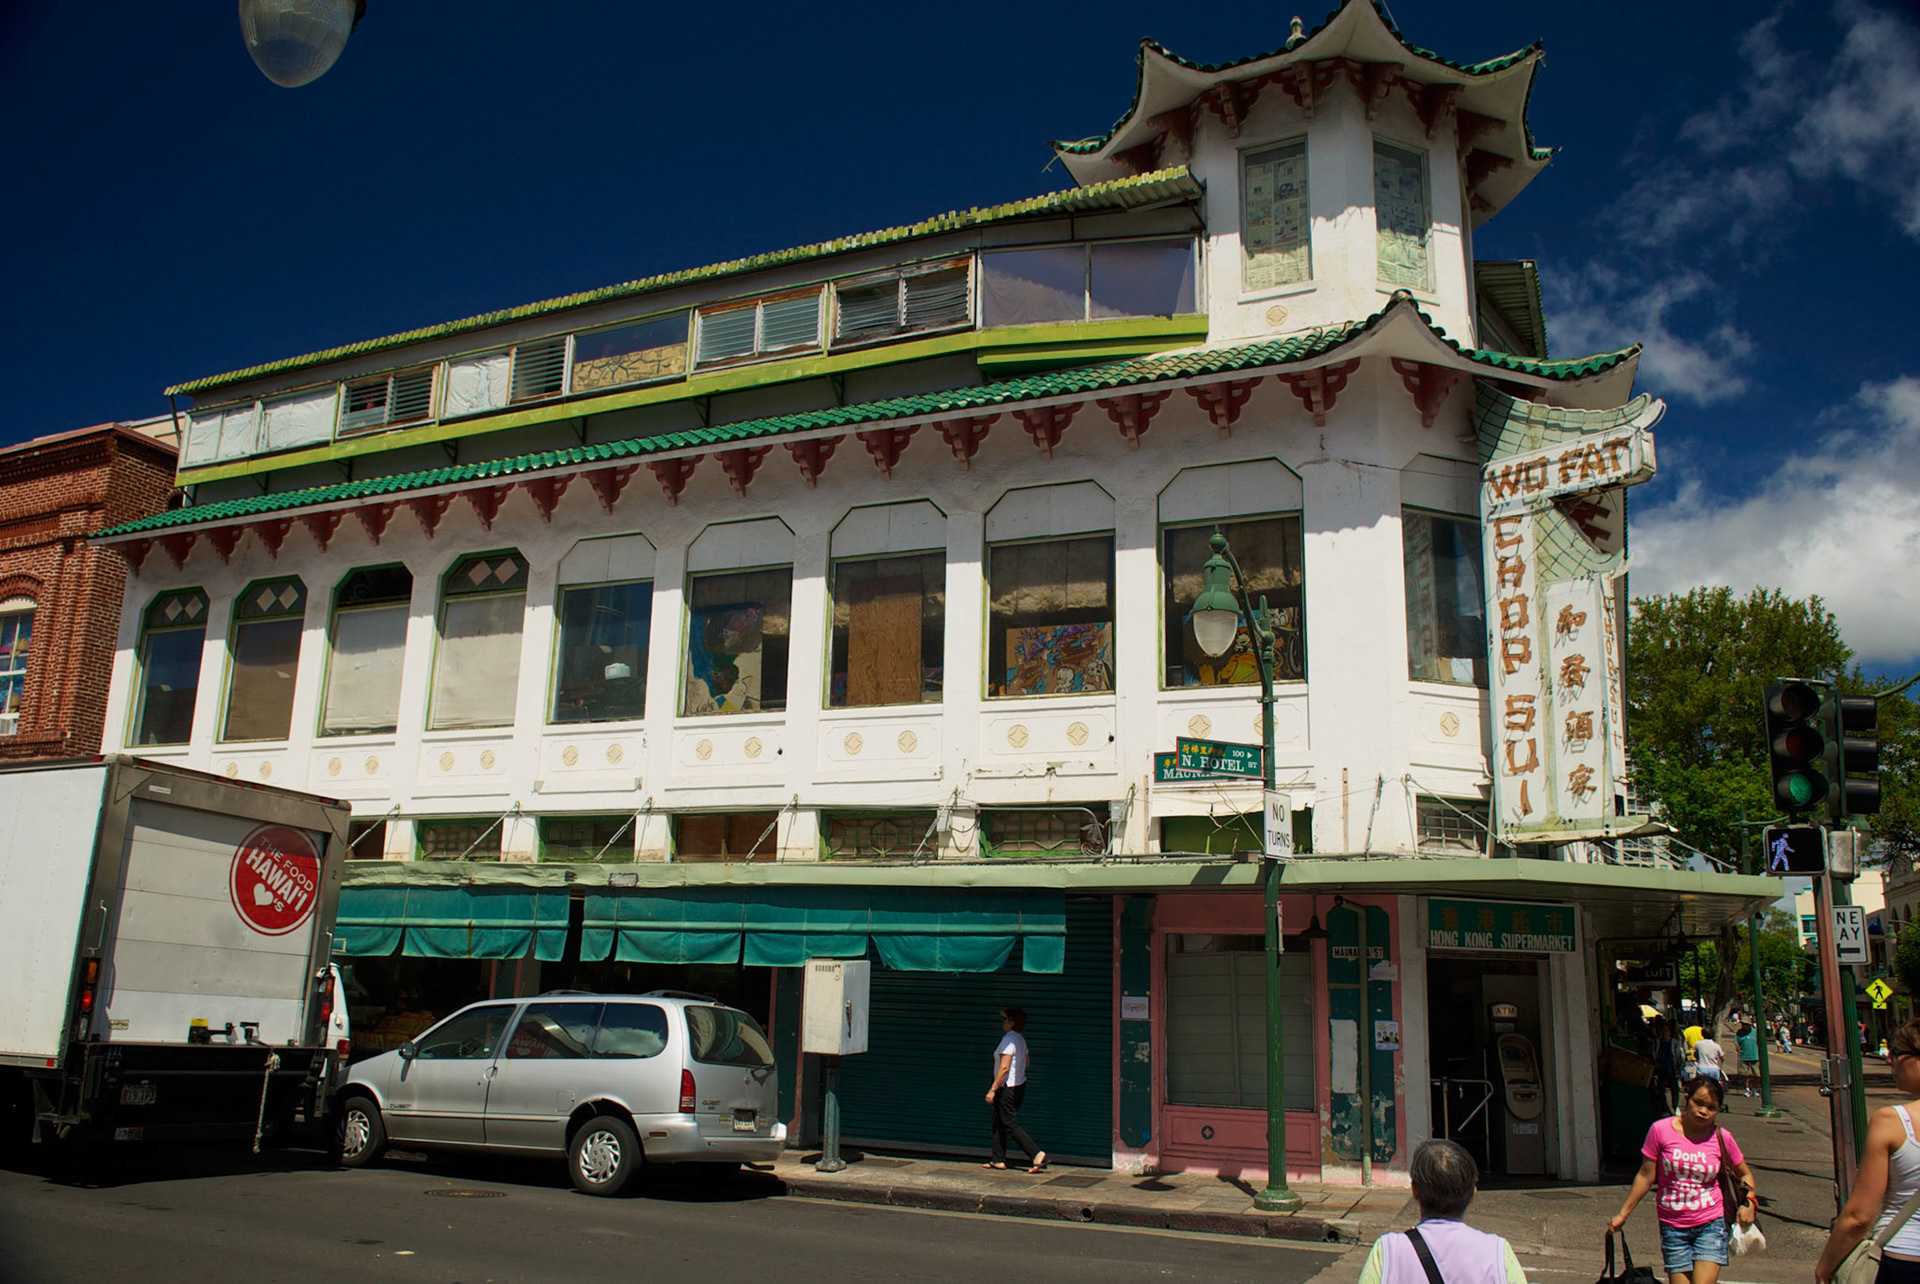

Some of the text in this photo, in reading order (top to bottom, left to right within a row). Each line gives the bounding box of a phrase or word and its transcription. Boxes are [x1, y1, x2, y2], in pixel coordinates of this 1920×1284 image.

[1486, 437, 1632, 500] WO FAT
[1493, 512, 1537, 818] CHOP SUI
[1181, 754, 1195, 767] N.
[1200, 756, 1245, 772] HOTEL
[1248, 761, 1258, 769] ST
[1232, 750, 1245, 758] 100
[1272, 803, 1285, 823] NO
[1267, 829, 1291, 849] TURNS
[260, 836, 314, 892] THE FOOD
[1836, 911, 1858, 924] NE
[1430, 929, 1574, 951] HONG KONG SUPERMARKET
[1839, 927, 1860, 940] AY
[1495, 1007, 1516, 1015] ATM
[1672, 1148, 1708, 1163] Don't
[1662, 1157, 1719, 1183] PUSH
[1661, 1187, 1716, 1211] LUCK
